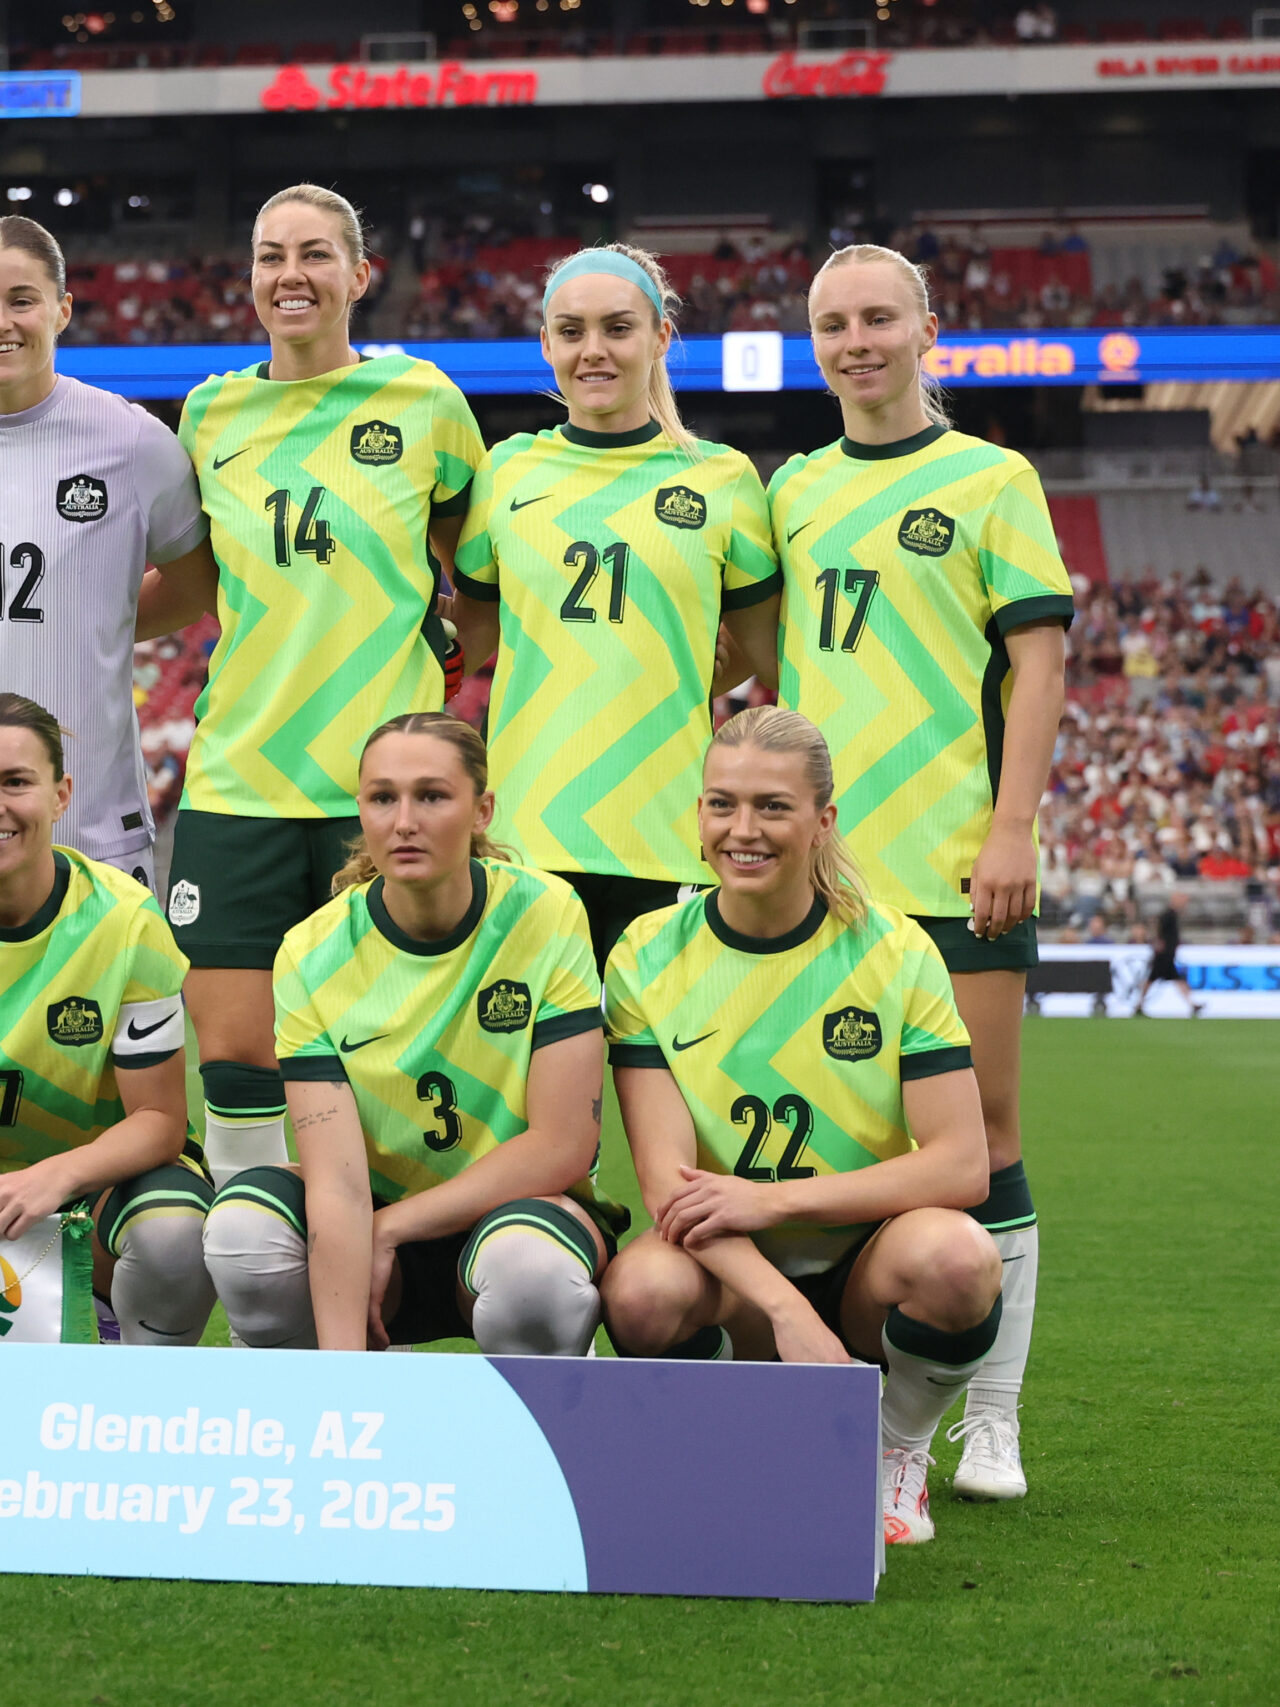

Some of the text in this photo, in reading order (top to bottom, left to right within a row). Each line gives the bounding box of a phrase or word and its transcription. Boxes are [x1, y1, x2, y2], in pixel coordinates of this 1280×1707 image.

[264, 486, 336, 567] 14
[560, 540, 631, 623] 21
[815, 568, 880, 653] 17
[417, 1070, 462, 1153] 3
[730, 1094, 817, 1182] 22
[38, 1402, 385, 1465] Glendale, AZ
[226, 1476, 305, 1535] 23,
[319, 1479, 457, 1532] 2025
